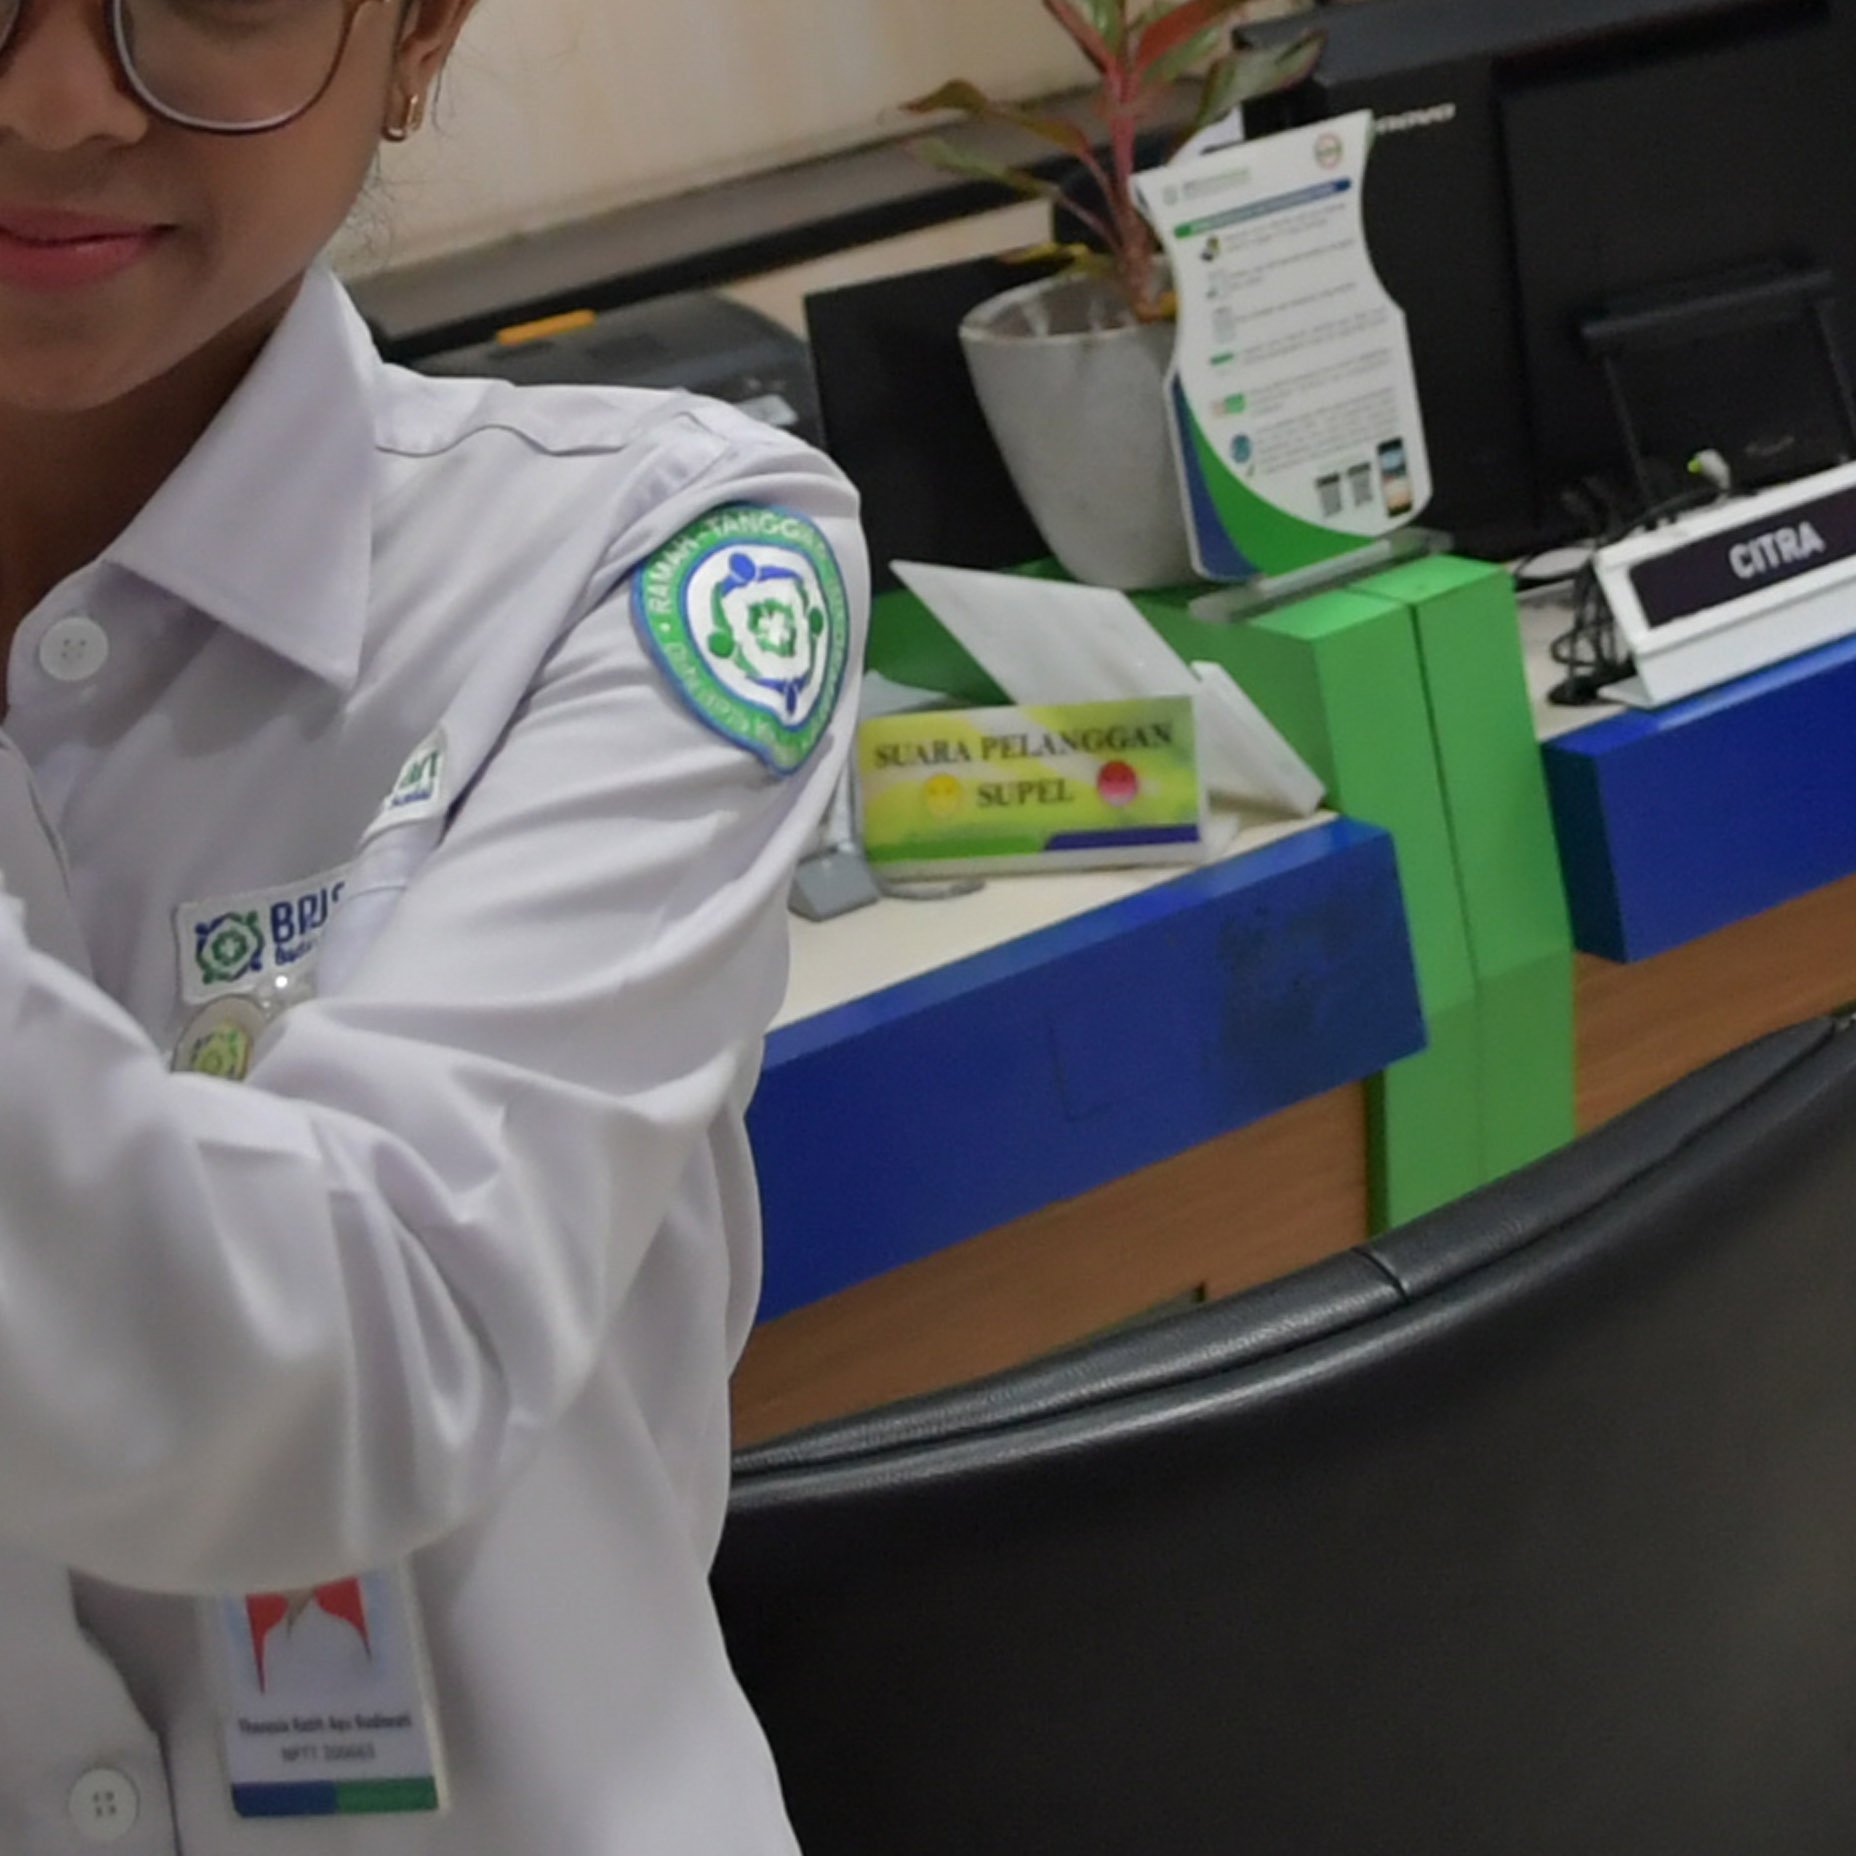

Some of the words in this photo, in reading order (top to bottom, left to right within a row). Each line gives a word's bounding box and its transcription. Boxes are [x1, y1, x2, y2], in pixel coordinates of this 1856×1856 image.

[1728, 520, 1826, 580] CITRA
[873, 739, 972, 769] SUARA
[980, 721, 1175, 762] PELANGGAN
[975, 777, 1075, 809] SUPEL
